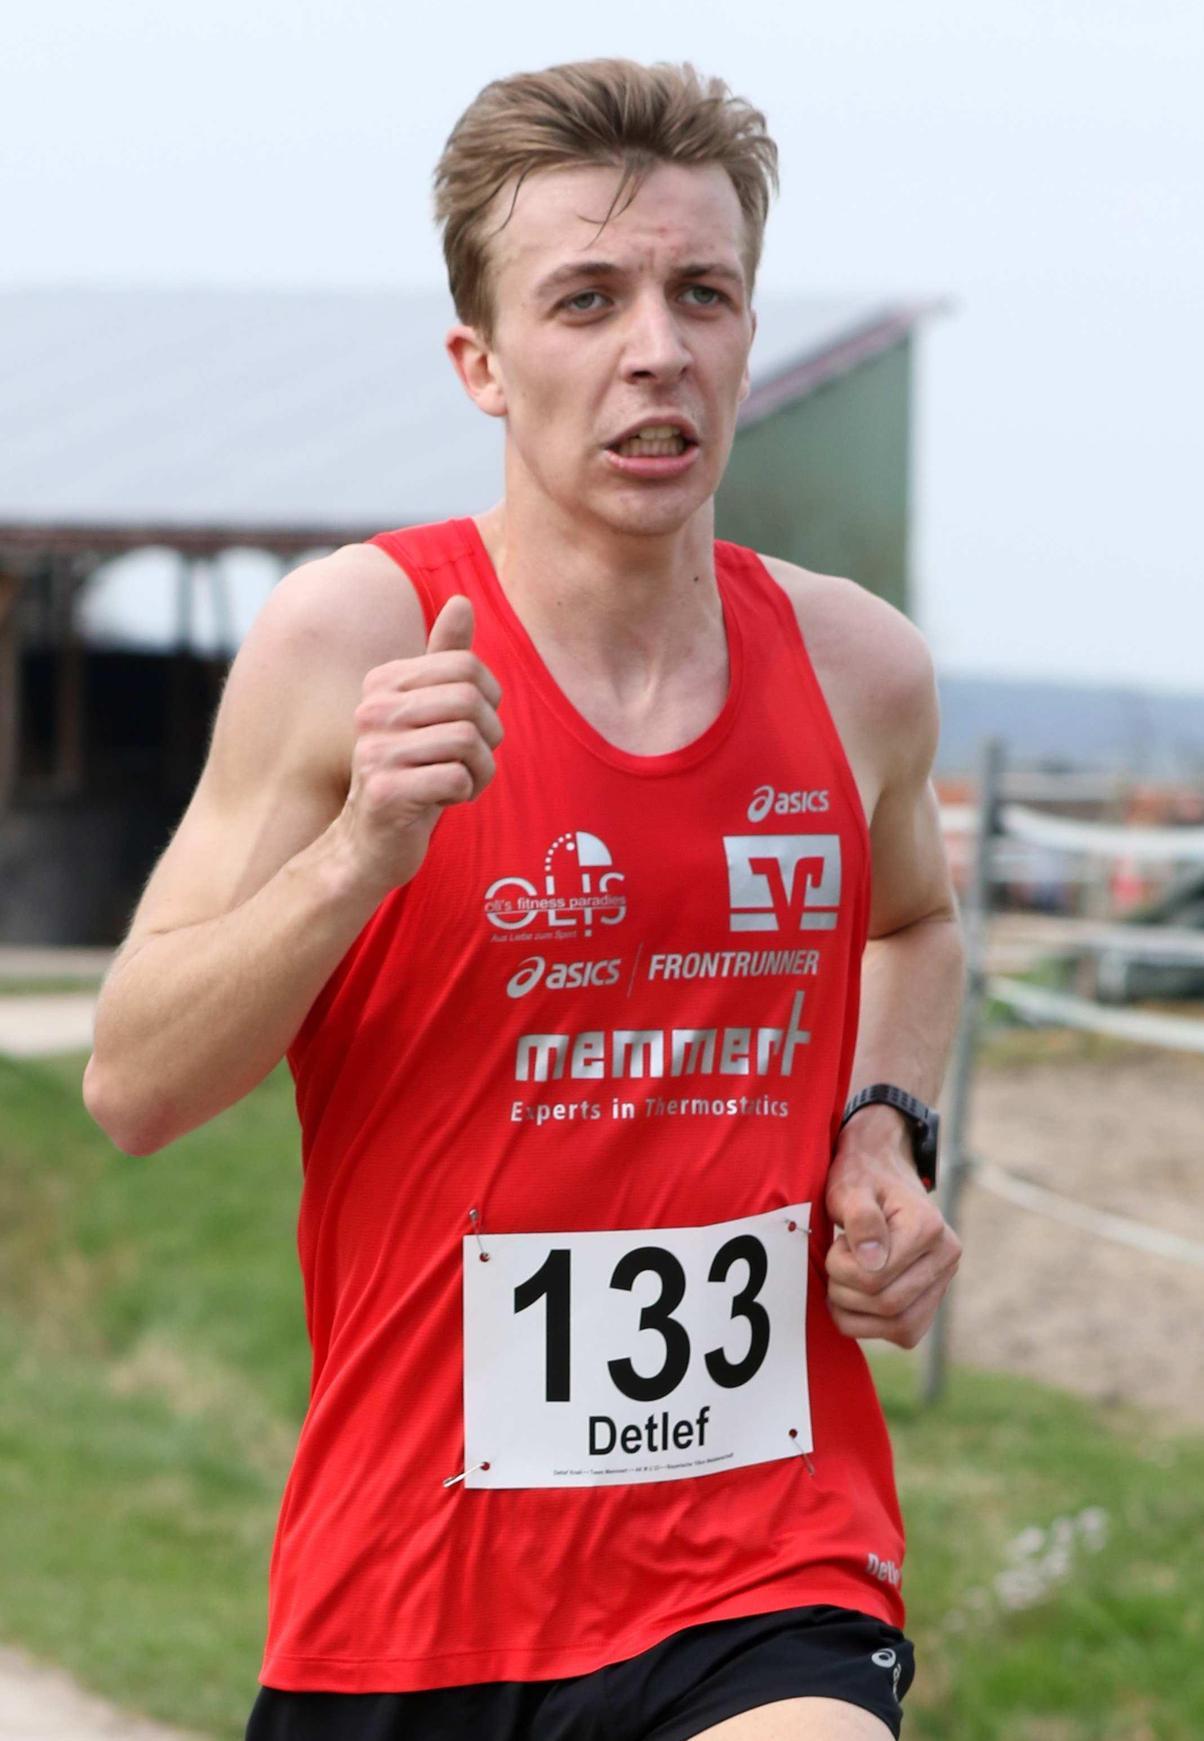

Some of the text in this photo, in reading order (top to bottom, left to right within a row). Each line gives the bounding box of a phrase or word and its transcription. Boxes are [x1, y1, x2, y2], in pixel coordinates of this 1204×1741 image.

[517, 897, 565, 910] fitness
[648, 949, 819, 980] FRONTRUNNER
[515, 990, 811, 1082] memmert
[510, 1094, 789, 1126] Experts in Thermosttics
[514, 1234, 770, 1402] 133
[588, 1406, 711, 1456] Detlef
